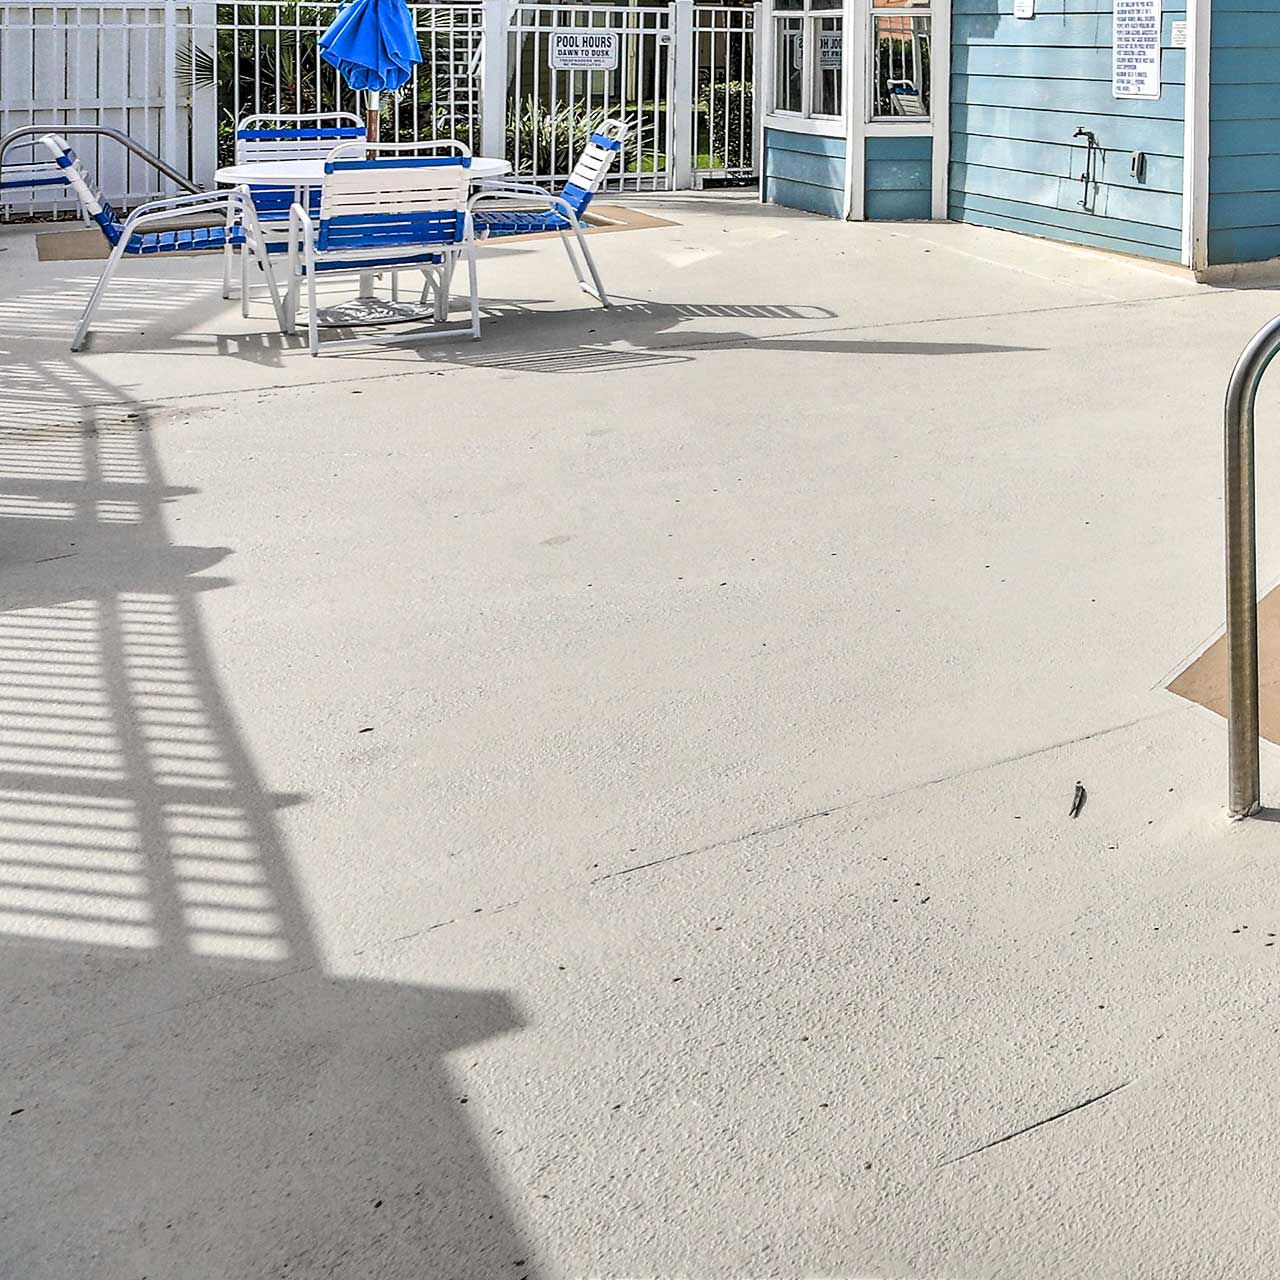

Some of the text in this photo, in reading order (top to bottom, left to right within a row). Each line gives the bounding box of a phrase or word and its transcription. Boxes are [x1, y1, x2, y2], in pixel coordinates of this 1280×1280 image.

[556, 35, 612, 48] POOL HOURS
[581, 49, 590, 57] TO
[591, 49, 610, 57] DUSK
